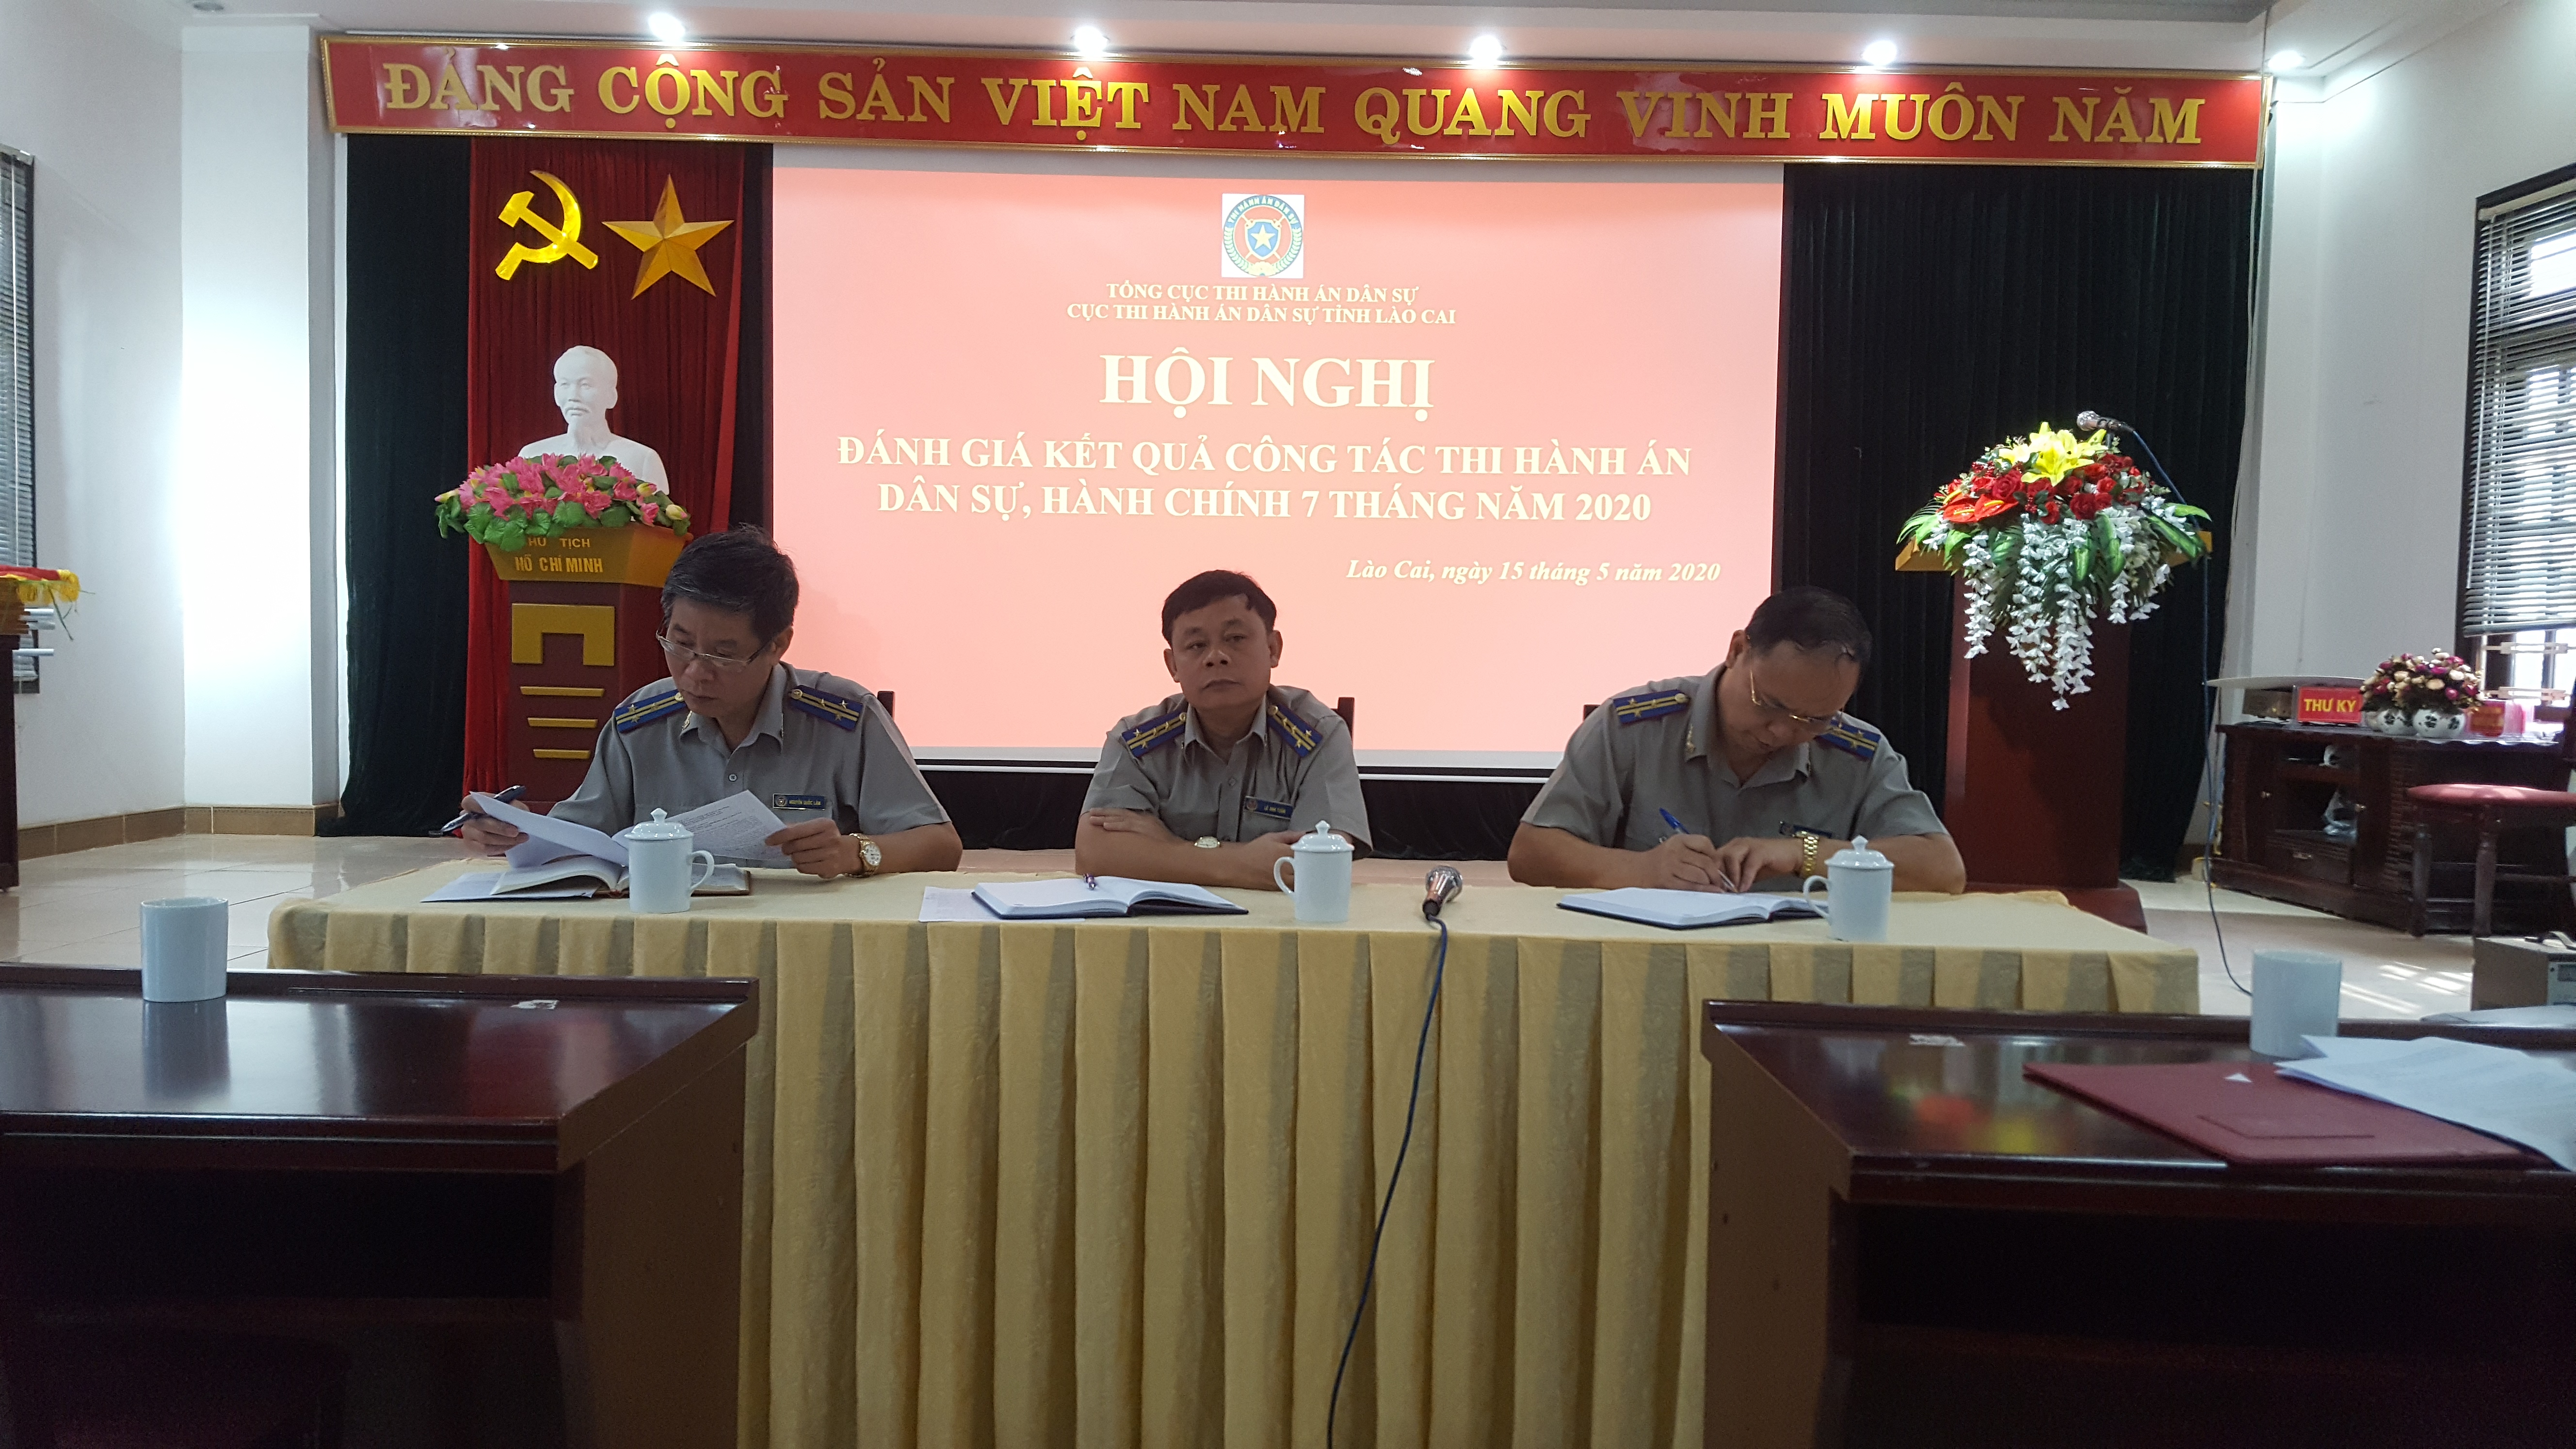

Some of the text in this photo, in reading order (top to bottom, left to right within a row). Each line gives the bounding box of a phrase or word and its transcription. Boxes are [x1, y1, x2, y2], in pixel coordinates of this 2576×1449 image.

[383, 47, 2206, 145] ĐẢNG CỘNG SẢN VIỆT NAM QUANG VINH MUÔN NĂM
[1107, 280, 1419, 306] TỔNG CỤC THI HÀNH ÁN DÂN SỰ
[1067, 303, 1456, 325] CỤC THI HÀNH ÁN DÂN SỰ TỈNH LÀO CAI
[1099, 347, 1435, 422] HỘI NGHỊ
[837, 429, 1692, 476] ĐÁNH GIÁ KẾT QUẢ CÔNG TÁC THI HÀNH ÁN
[878, 475, 1651, 521] DÂN SỰ, HÀNH CHÍNH 7 THÁNG NĂM 2020
[560, 538, 590, 549] TỊCH
[539, 555, 562, 572] CHÍ
[565, 558, 603, 573] MINH
[1346, 560, 1721, 586] Lào Cai, ngày 15 tháng 5 năm 2020
[2303, 698, 2334, 712] THƯ
